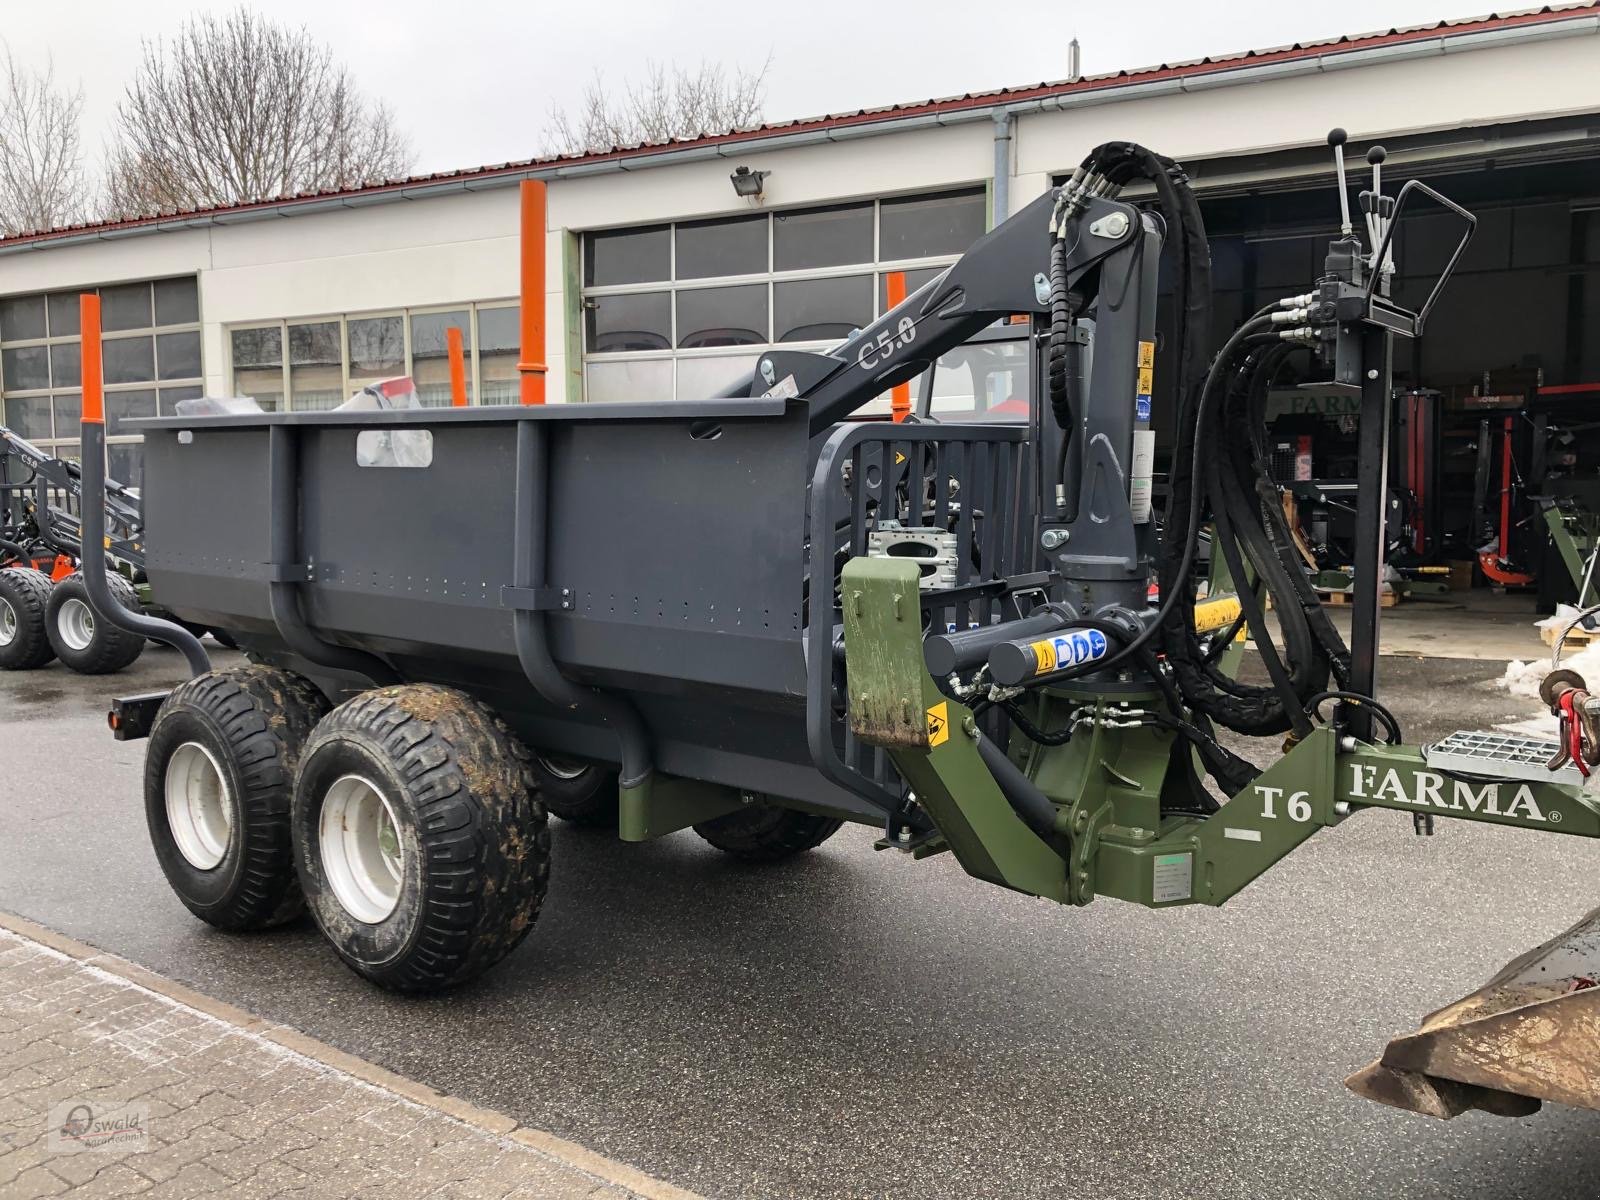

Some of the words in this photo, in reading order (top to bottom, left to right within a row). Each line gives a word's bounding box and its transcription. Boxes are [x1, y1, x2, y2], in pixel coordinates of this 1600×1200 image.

[858, 316, 916, 370] C5.0
[1289, 395, 1361, 415] FARM
[1254, 785, 1312, 823] T6
